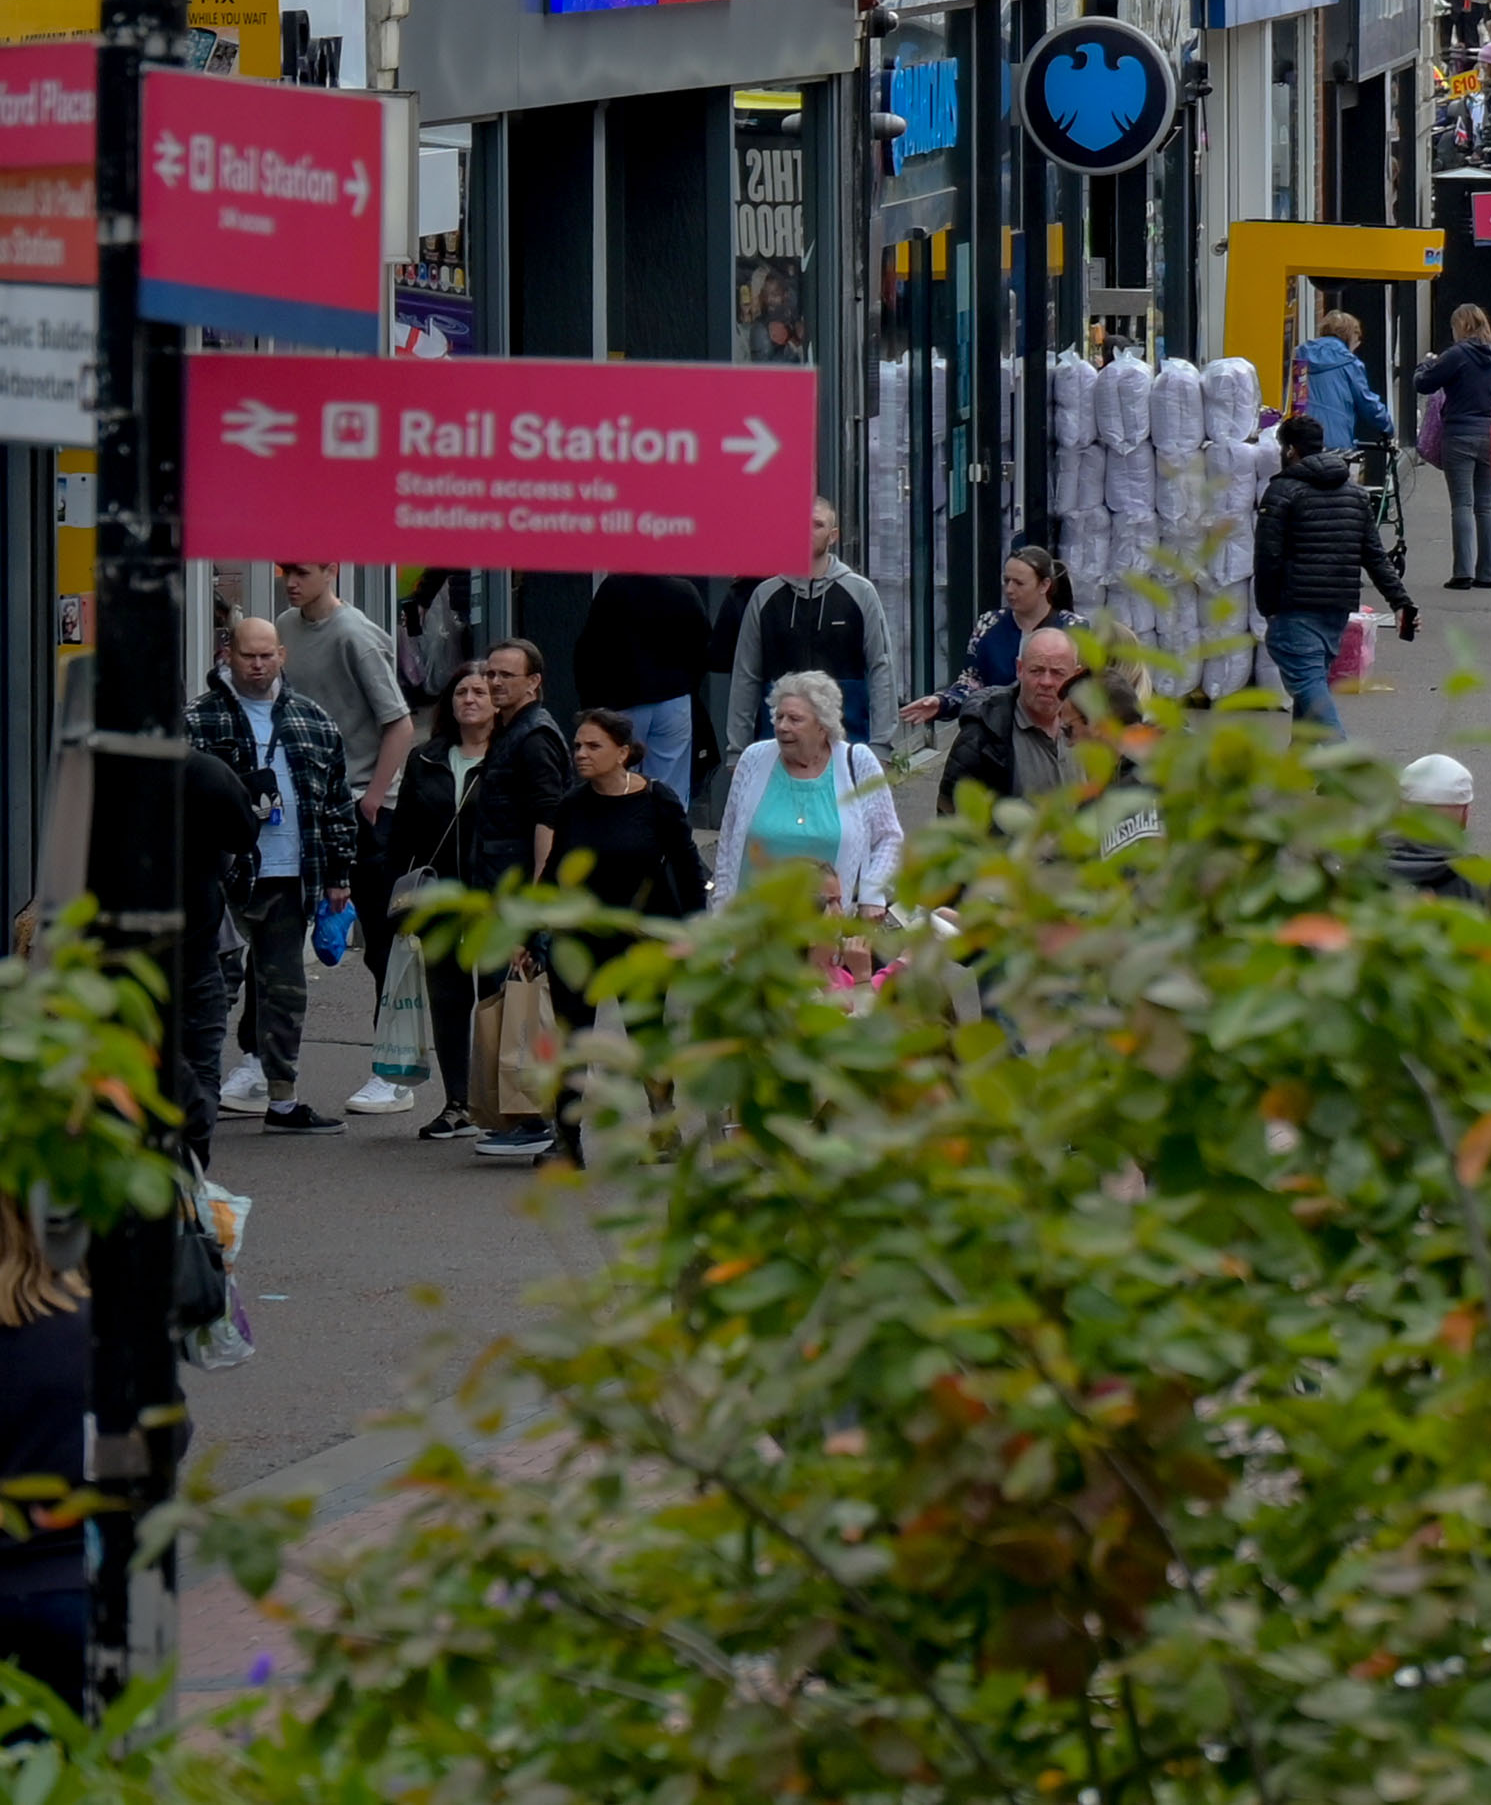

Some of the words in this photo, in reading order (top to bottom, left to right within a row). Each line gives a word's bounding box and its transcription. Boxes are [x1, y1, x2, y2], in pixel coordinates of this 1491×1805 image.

[188, 13, 218, 25] WHILE
[222, 13, 240, 25] YOU
[243, 12, 268, 25] WAIT
[41, 81, 94, 126] Place
[1453, 78, 1477, 94] £10
[219, 144, 255, 192] Rail
[261, 150, 338, 204] Station
[400, 411, 494, 459] Rail
[509, 415, 698, 464] Station
[397, 471, 486, 497] Station
[491, 480, 573, 500] access
[579, 476, 616, 501] via
[396, 503, 502, 531] Saddlers
[508, 508, 594, 532] Centre
[600, 510, 631, 534] till
[637, 513, 695, 539] 6pm
